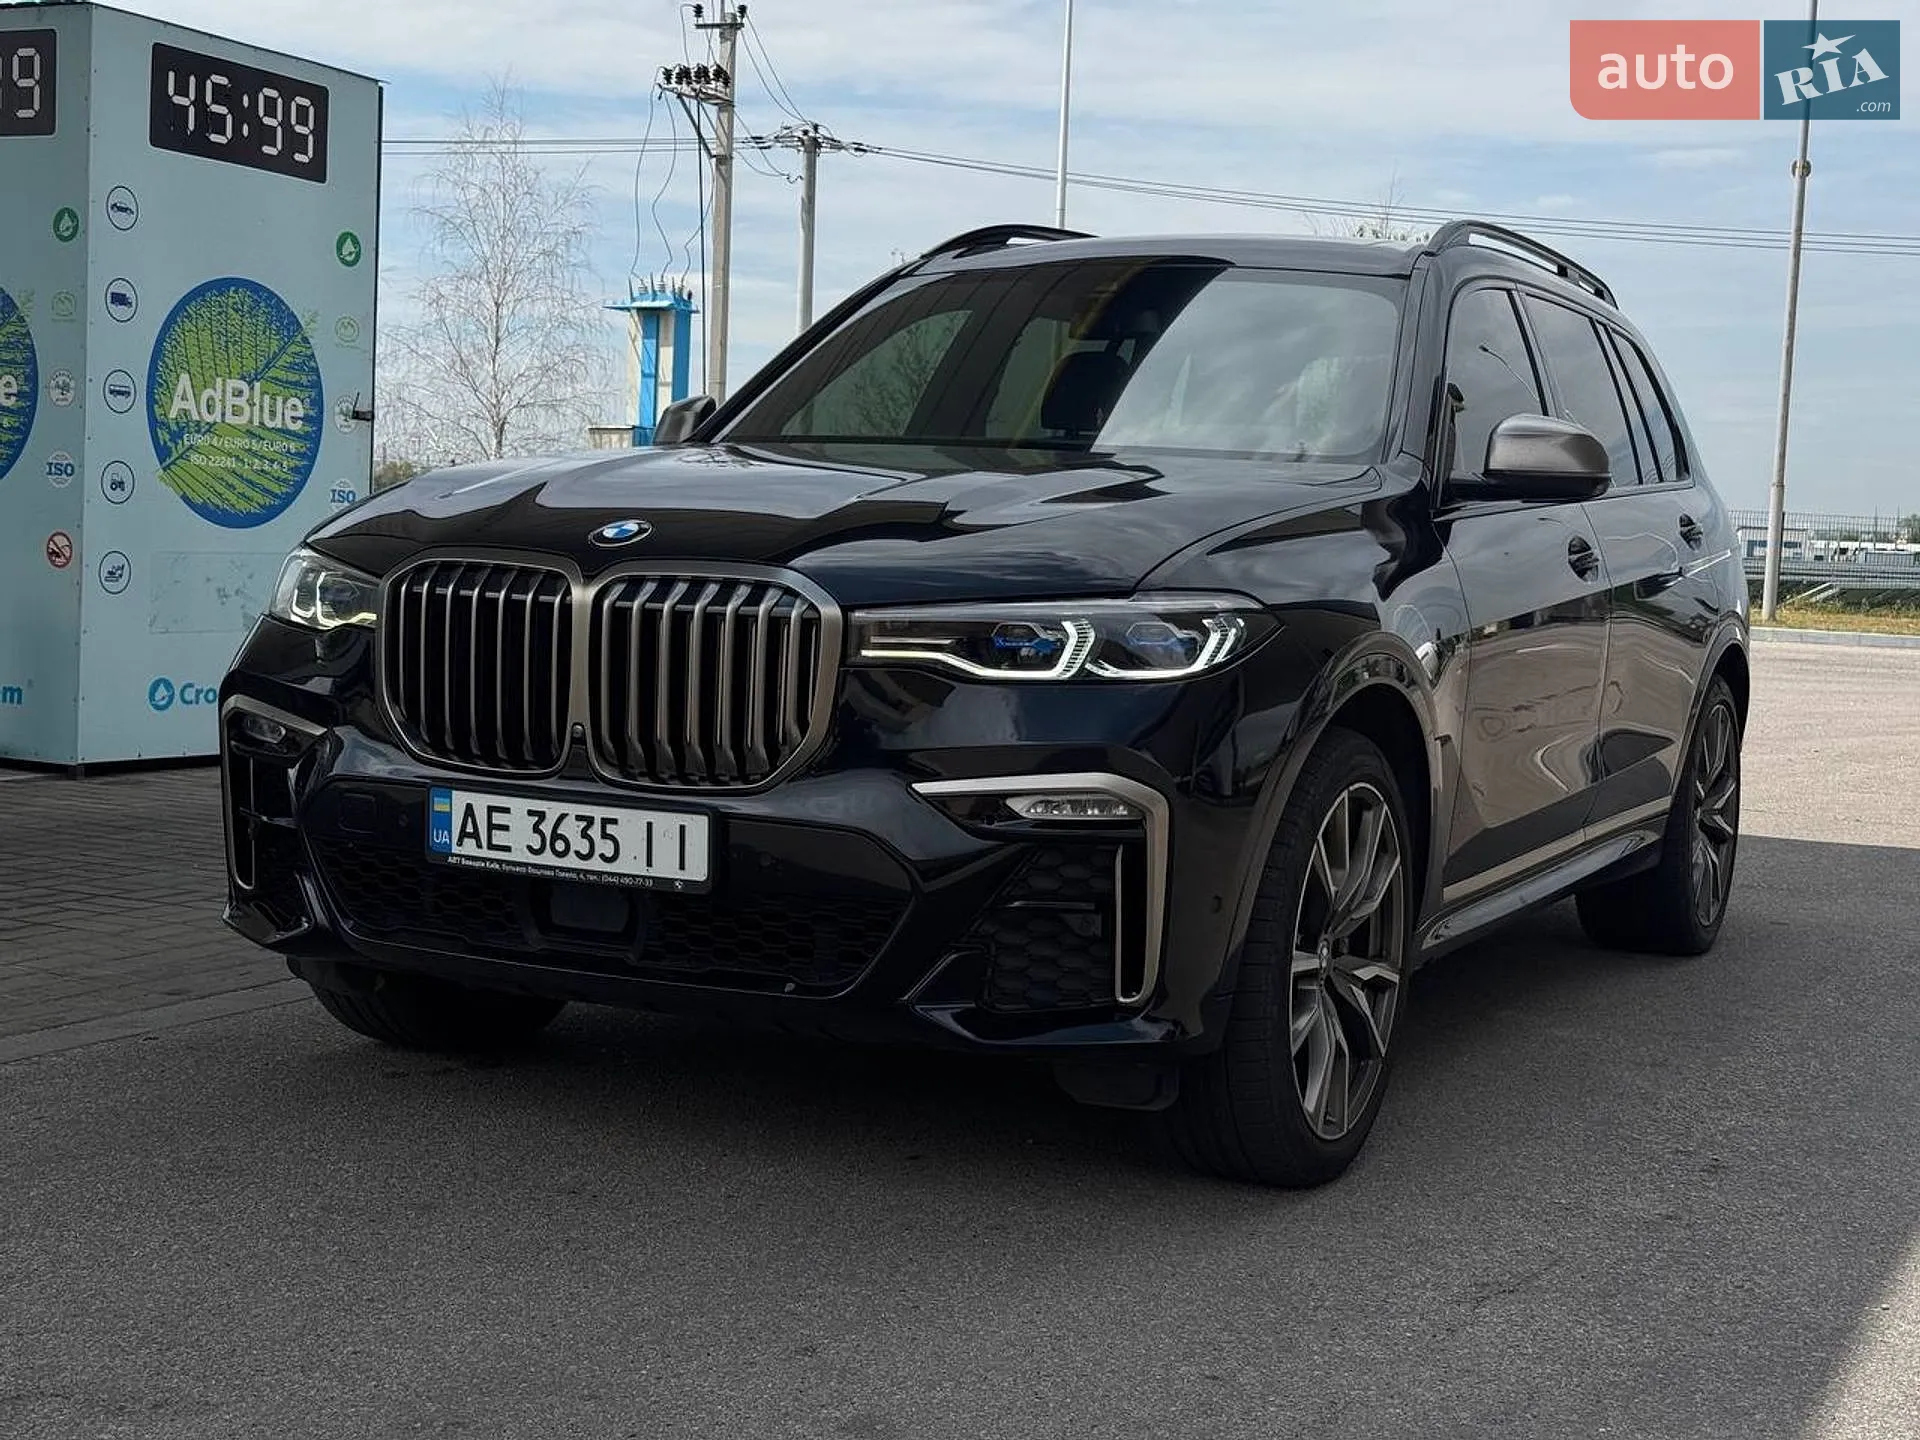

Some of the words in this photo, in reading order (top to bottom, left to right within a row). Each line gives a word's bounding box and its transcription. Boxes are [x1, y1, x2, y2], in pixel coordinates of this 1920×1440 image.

[167, 69, 315, 164] 45:99
[169, 373, 305, 430] AdBlue
[46, 461, 76, 478] ISO
[330, 489, 356, 504] ISO
[433, 828, 450, 844] UA
[456, 802, 512, 852] AE
[526, 808, 621, 864] 3635
